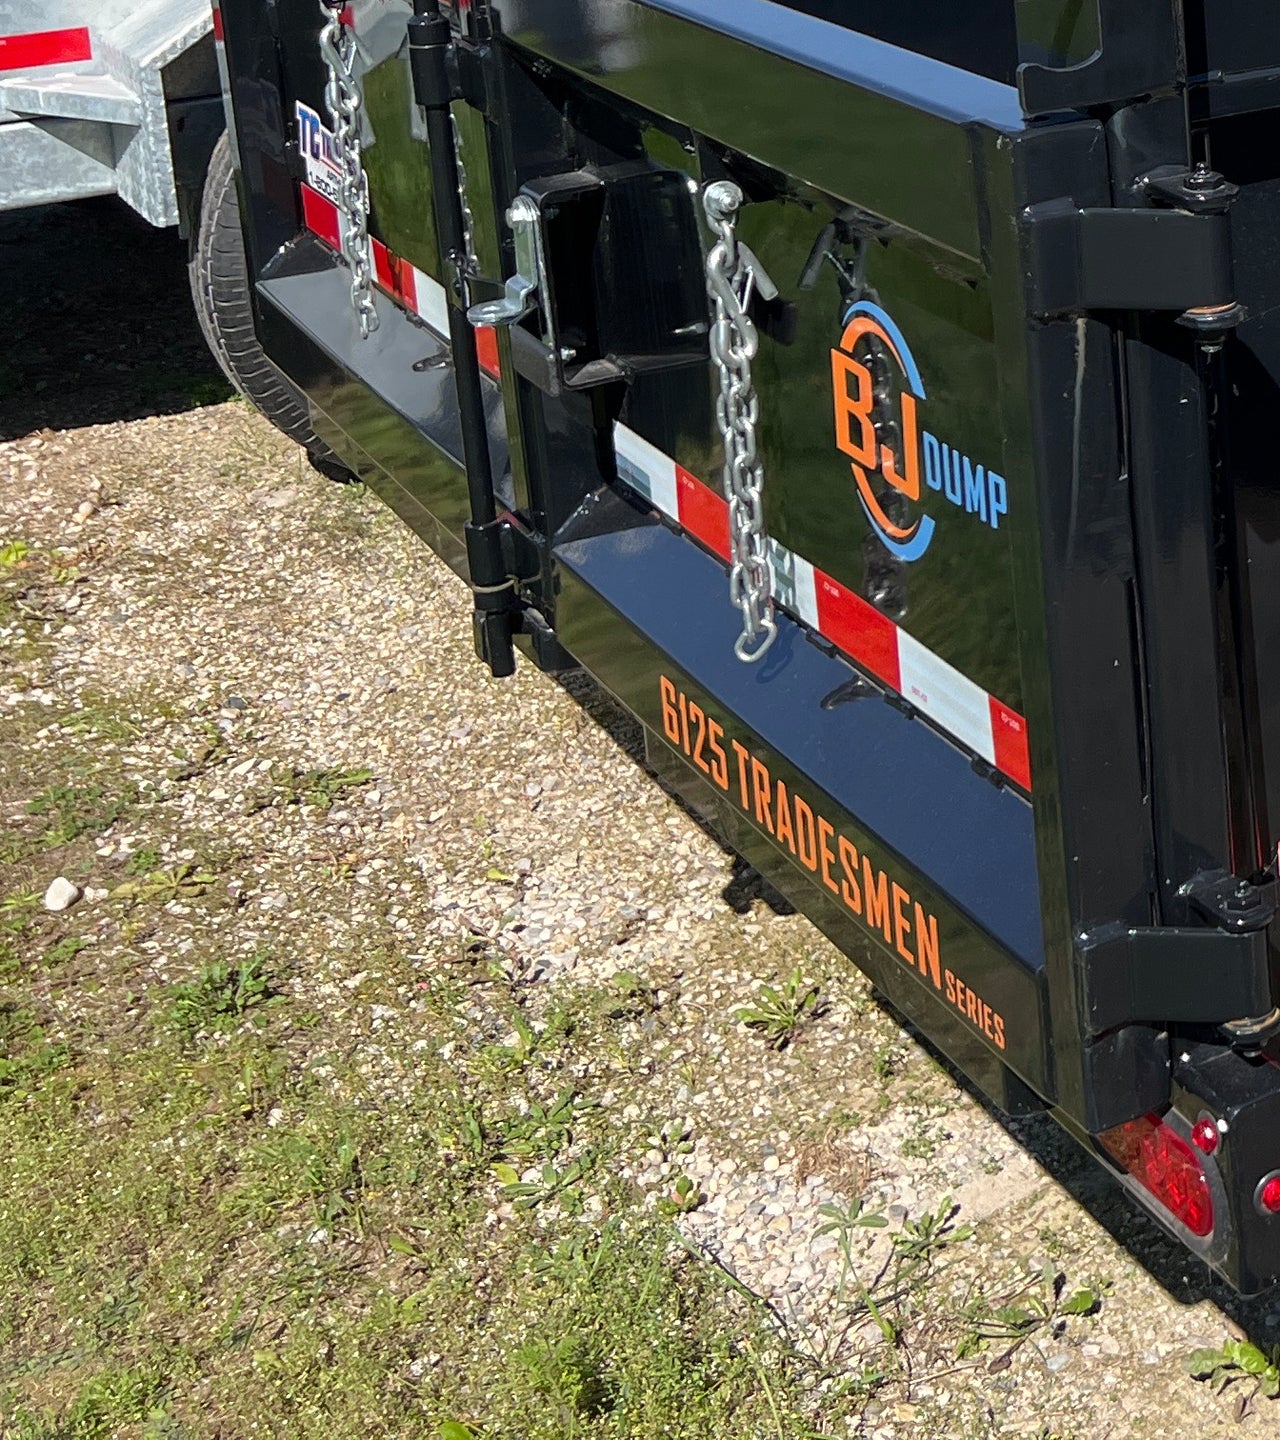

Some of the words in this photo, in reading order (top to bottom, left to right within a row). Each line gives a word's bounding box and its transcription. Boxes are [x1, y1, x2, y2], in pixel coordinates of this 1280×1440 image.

[831, 347, 920, 502] BJ
[922, 430, 1008, 529] DUMP
[659, 674, 729, 791] 6125
[731, 739, 942, 990] TRADESMEN
[945, 968, 1006, 1050] SERIES
